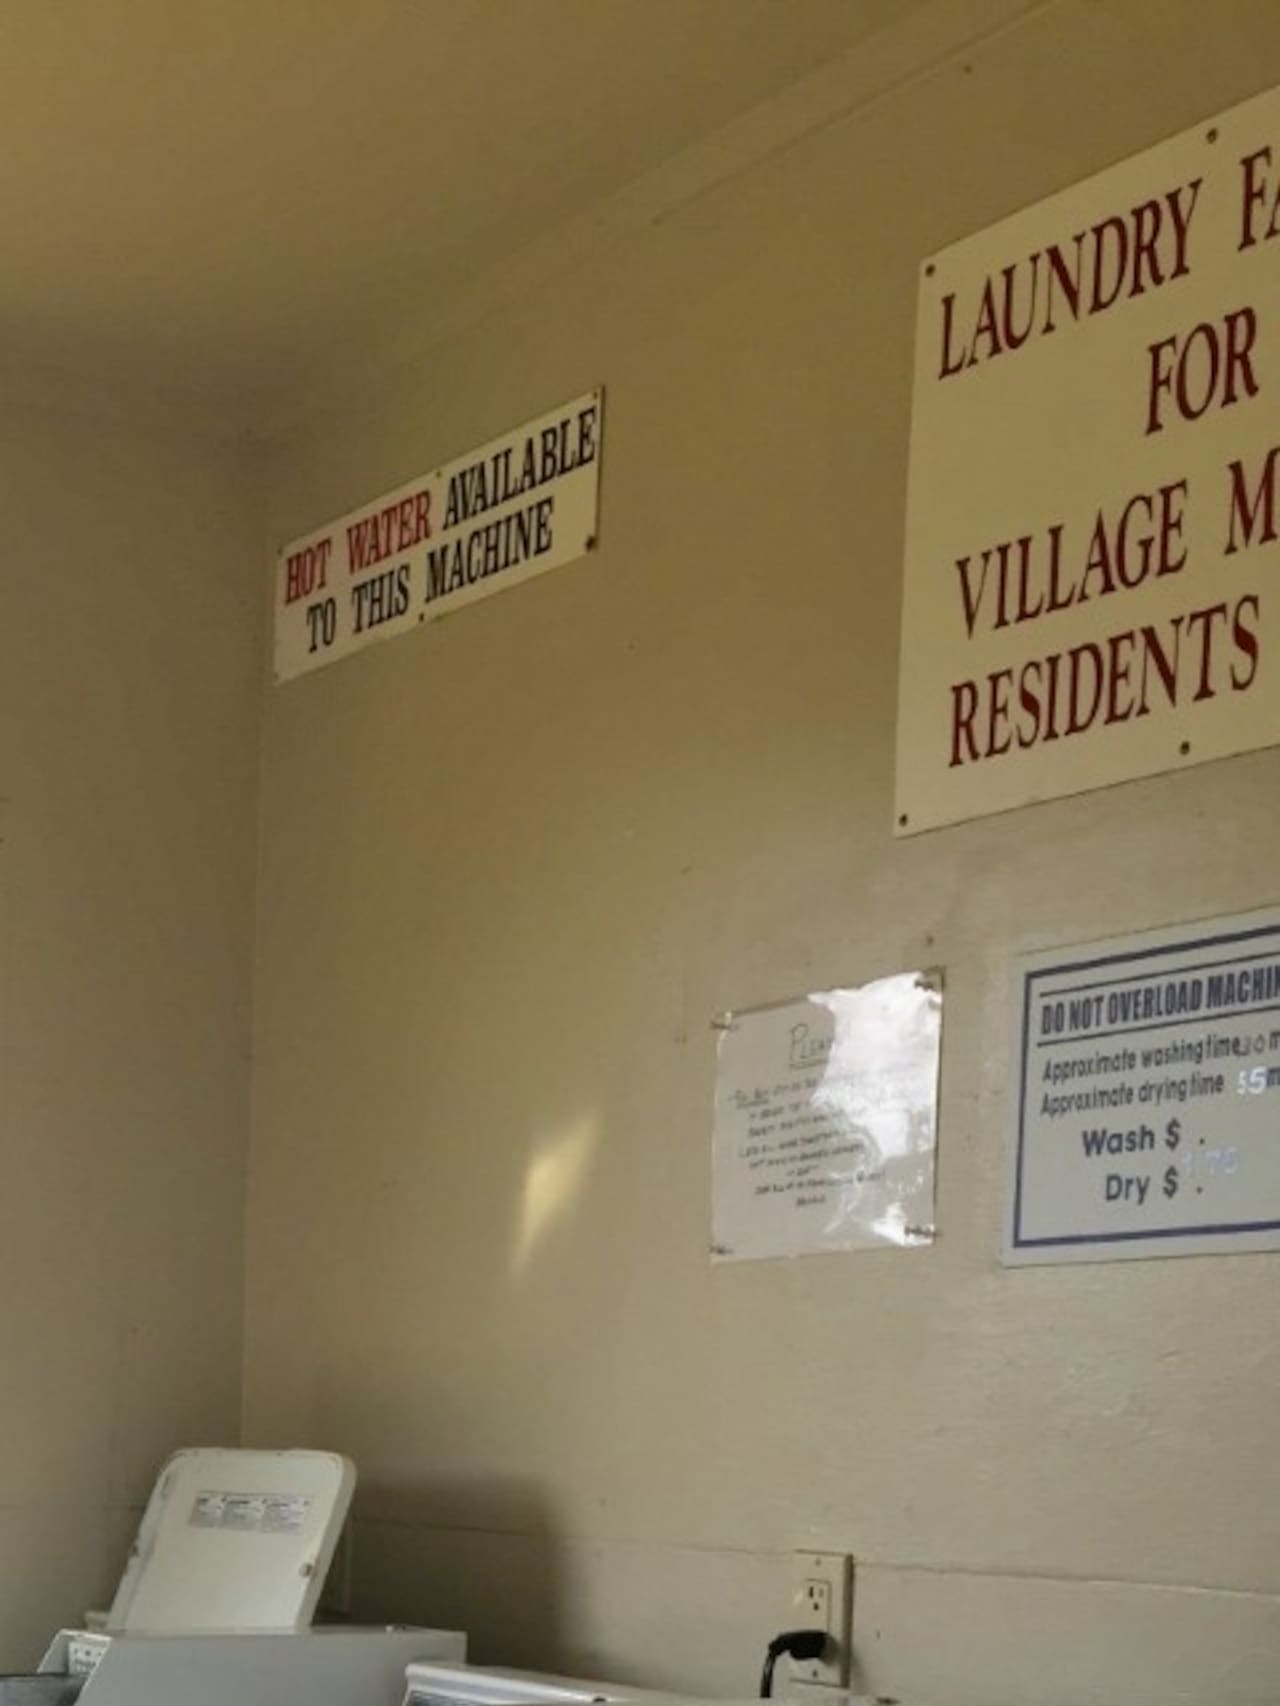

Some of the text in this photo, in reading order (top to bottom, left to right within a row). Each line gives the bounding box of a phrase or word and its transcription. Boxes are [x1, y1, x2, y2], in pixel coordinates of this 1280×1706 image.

[938, 178, 1203, 380] LAUNDRY
[1144, 306, 1260, 436] FOR
[284, 405, 597, 606] HOT WATER AVAILABLE
[954, 479, 1189, 641] VILLAGE
[306, 496, 554, 654] TO THIS MACHINE
[948, 594, 1260, 767] RESIDENTS
[1041, 1002, 1065, 1035] DO
[1069, 994, 1105, 1031] NOT
[1108, 978, 1203, 1025] OVERLOAD
[1041, 1050, 1136, 1086] Approximate
[1141, 1039, 1203, 1065] washing
[1040, 1082, 1134, 1118] Approximate
[1138, 1077, 1187, 1105] drying
[1189, 1071, 1225, 1097] time
[1082, 1124, 1155, 1157] Wash
[1165, 1117, 1181, 1151] $
[1105, 1173, 1151, 1206] Dry
[1163, 1166, 1179, 1199] $
